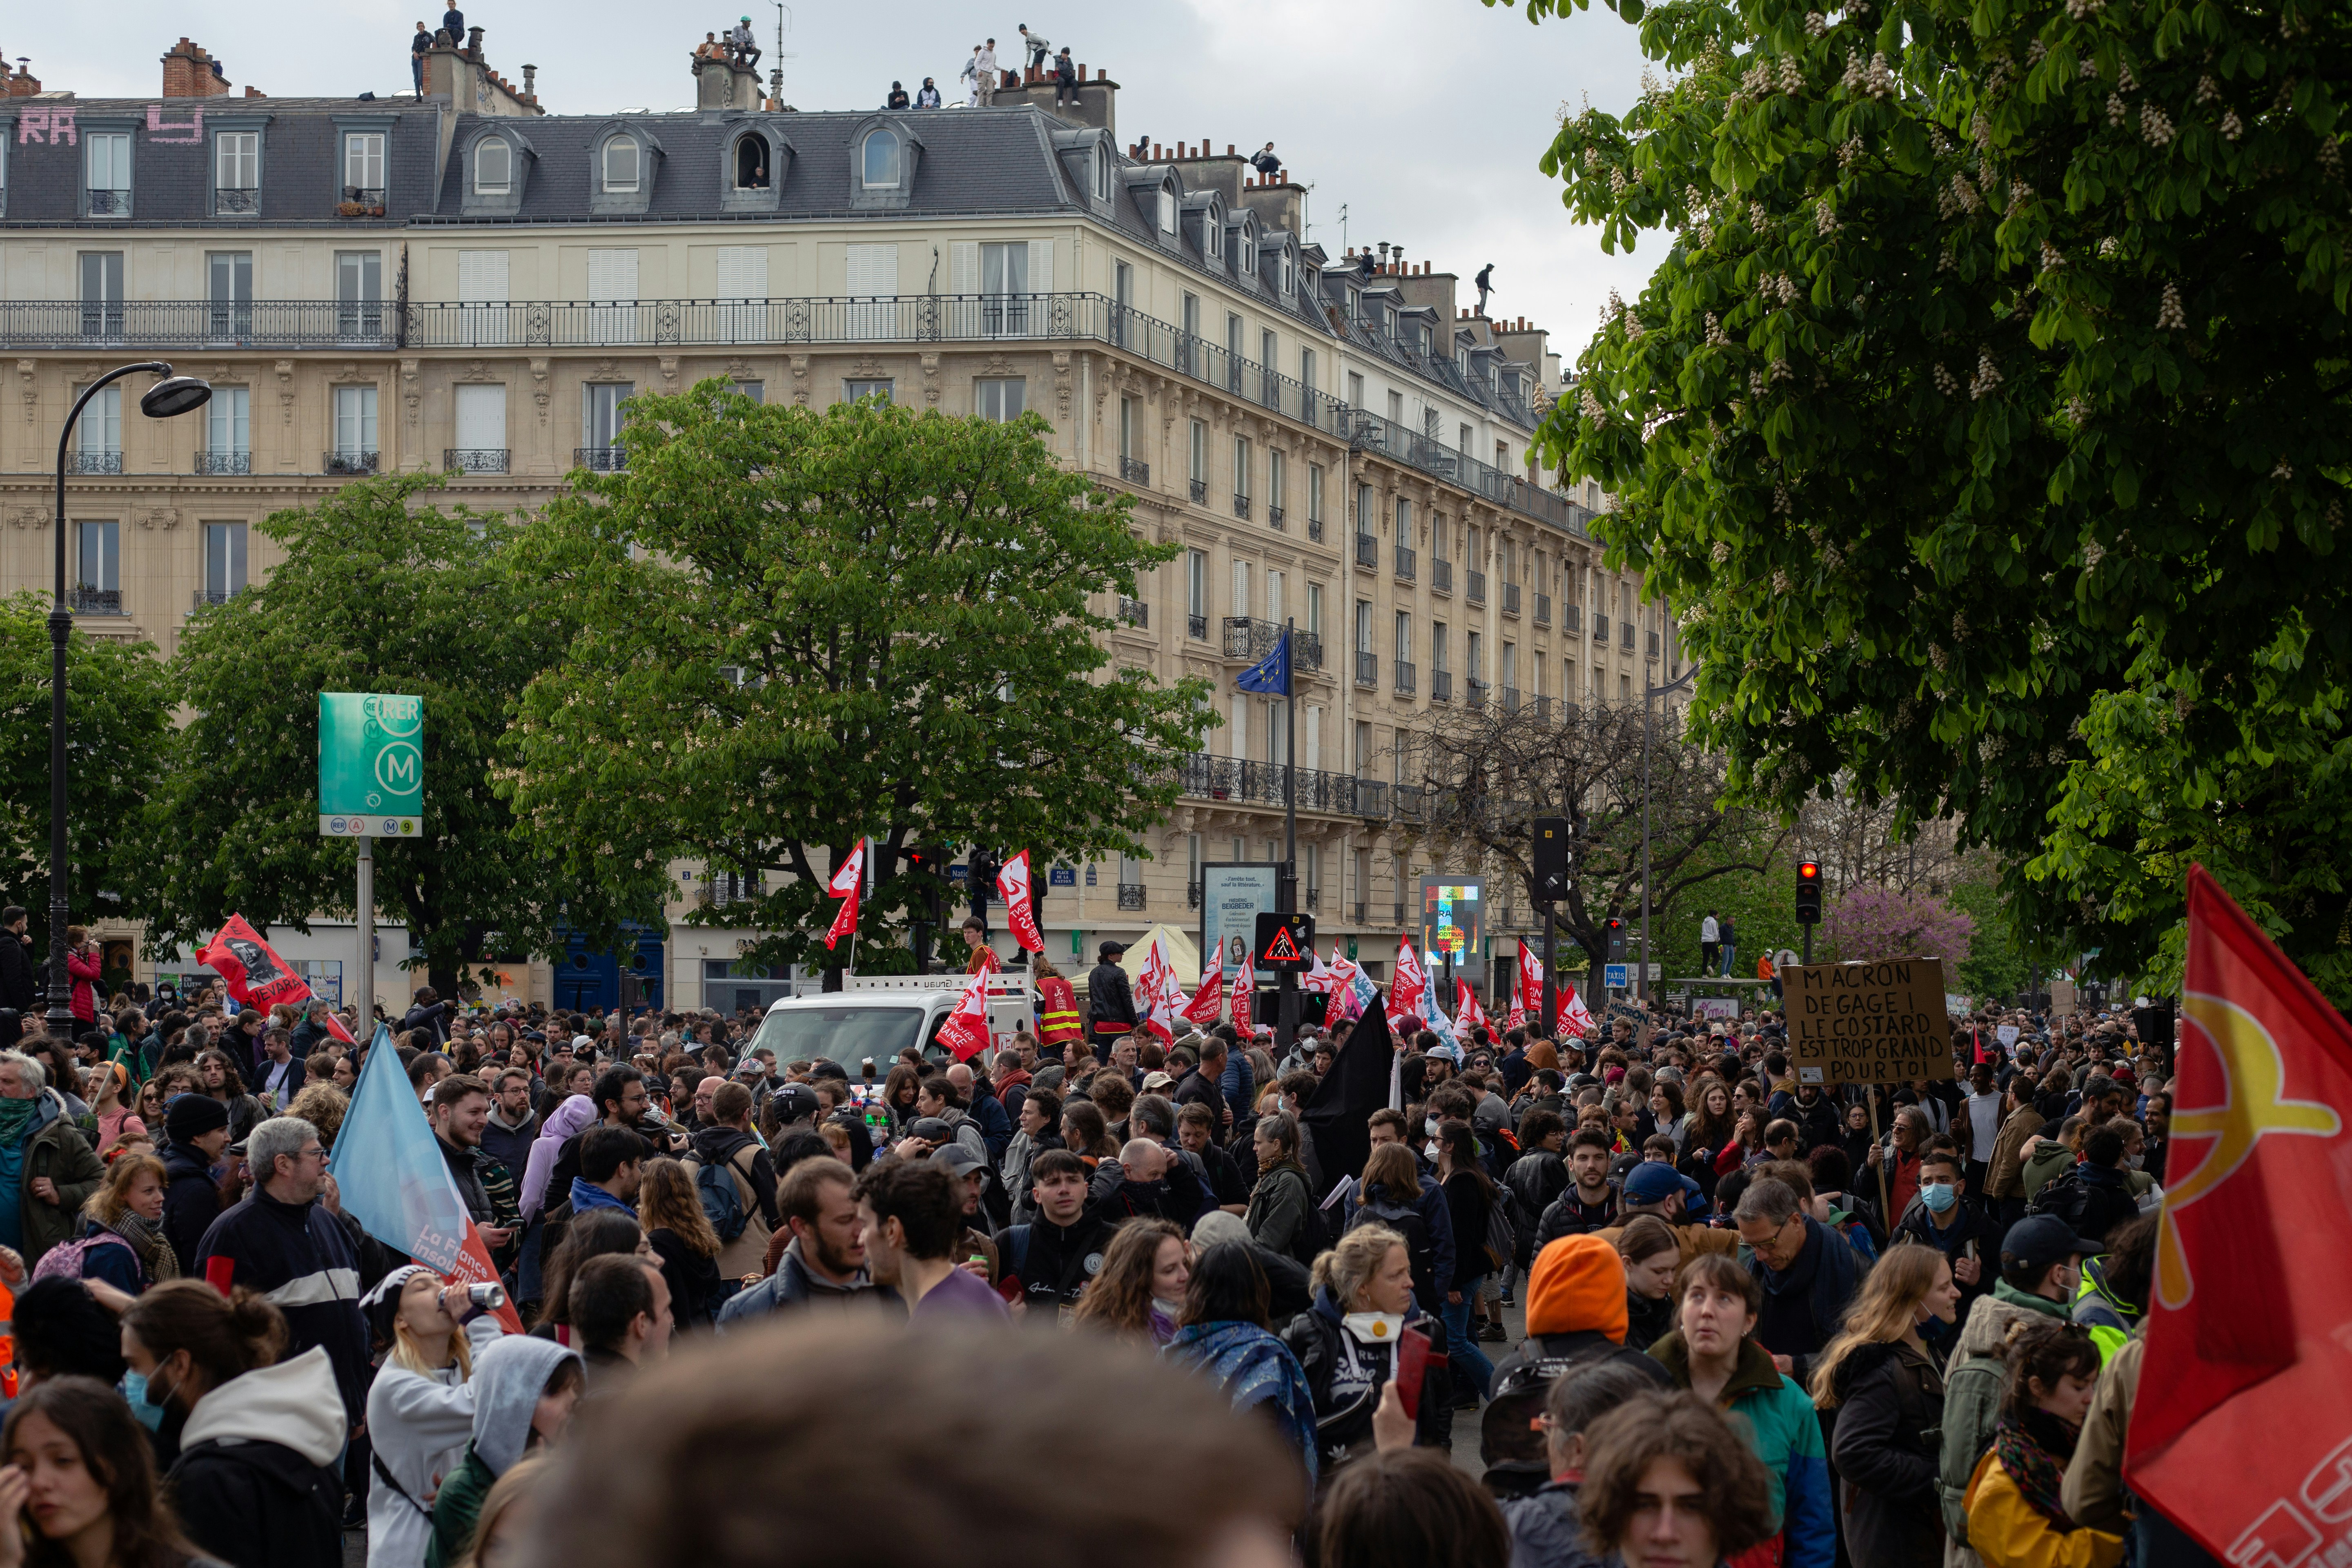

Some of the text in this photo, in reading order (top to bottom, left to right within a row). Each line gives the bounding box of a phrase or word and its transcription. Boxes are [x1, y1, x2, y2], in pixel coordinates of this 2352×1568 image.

[383, 699, 418, 720] RER
[388, 753, 414, 783] M
[387, 822, 395, 831] M
[404, 822, 410, 831] 9
[252, 978, 302, 1004] UEVARA
[1806, 992, 1898, 1014] DEGAGE
[1559, 1014, 1584, 1033] MOUVEM
[1801, 1013, 1930, 1039] LE COSTARD
[1799, 1035, 1943, 1059] EST TROP GRAND
[1831, 1060, 1886, 1080] POUR
[412, 1238, 483, 1283] insoumis
[419, 1224, 487, 1278] La France
